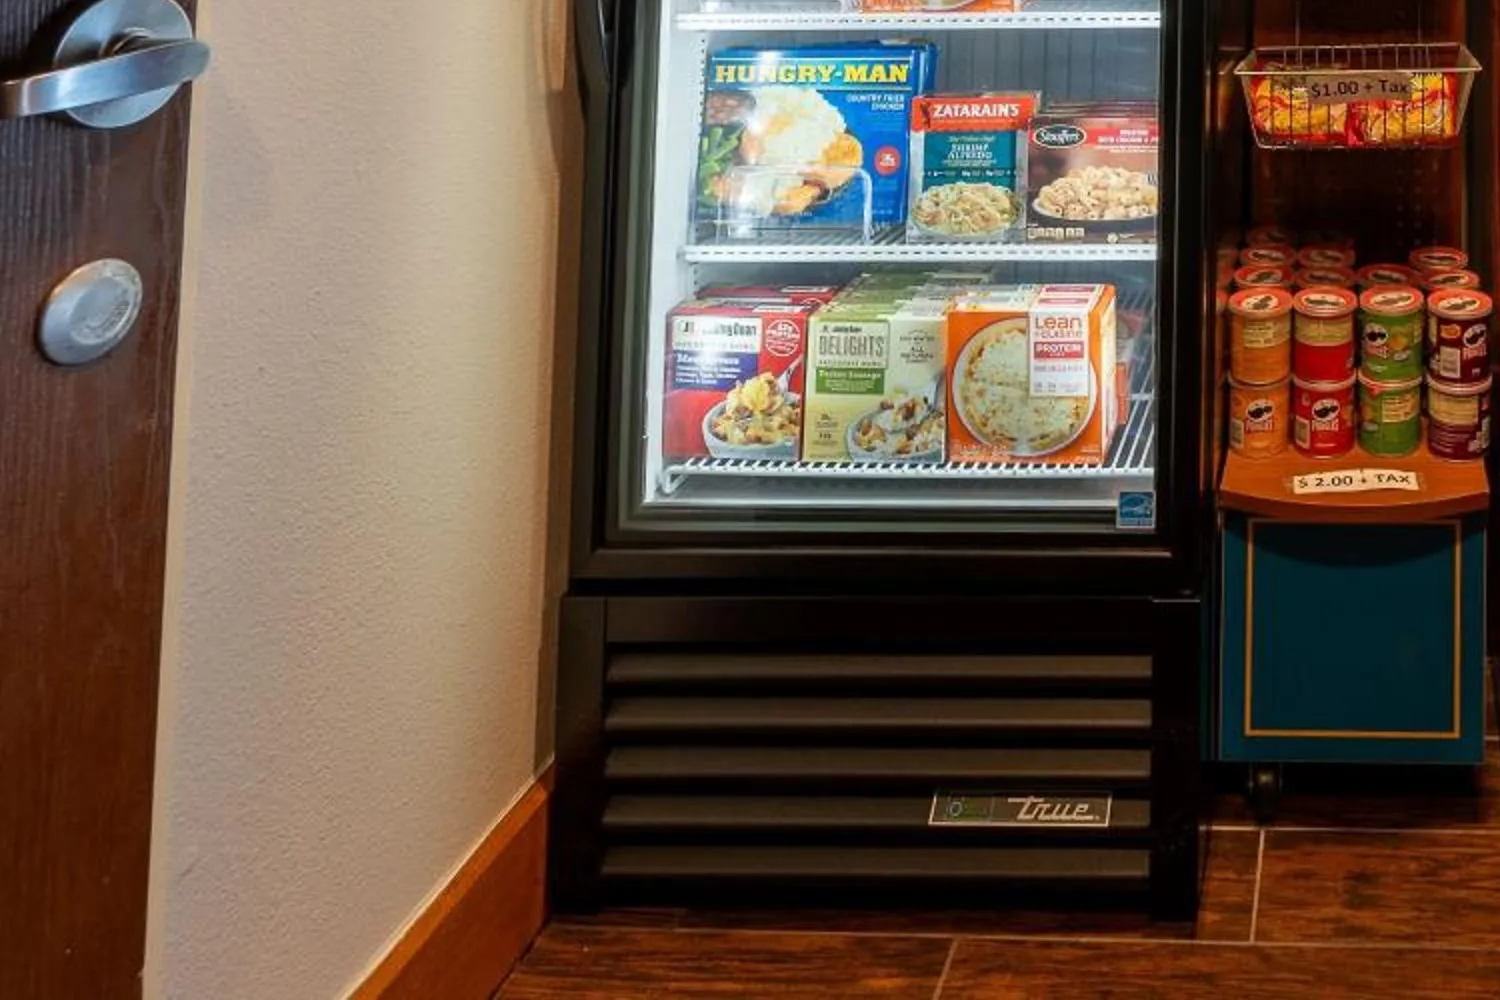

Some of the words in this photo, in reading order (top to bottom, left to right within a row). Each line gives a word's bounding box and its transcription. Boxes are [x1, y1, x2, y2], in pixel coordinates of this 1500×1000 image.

[714, 63, 909, 83] HUNGRY-MAN
[1311, 81, 1359, 98] $1.00
[1379, 79, 1409, 94] Tax
[1035, 316, 1082, 329] Lean
[818, 334, 885, 358] DELIGHTS
[1314, 474, 1353, 487] 2.00
[1374, 473, 1412, 485] TAX
